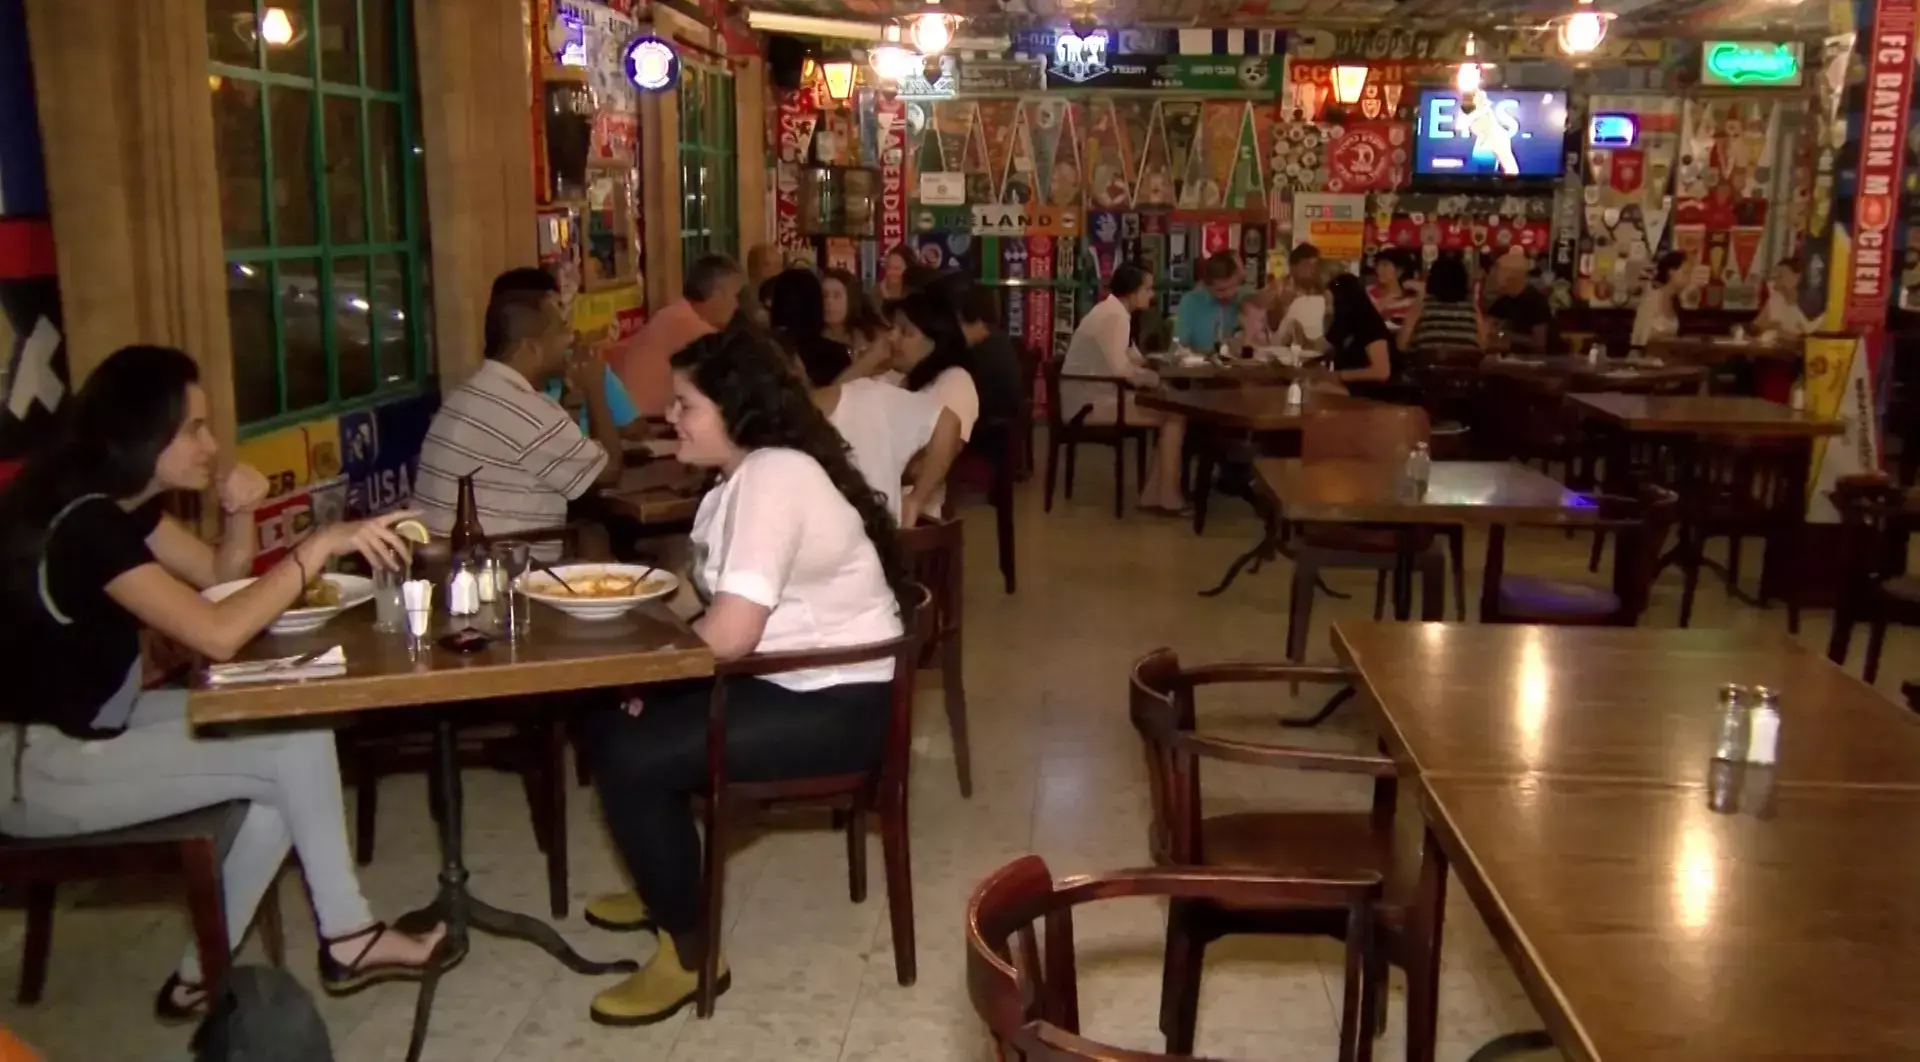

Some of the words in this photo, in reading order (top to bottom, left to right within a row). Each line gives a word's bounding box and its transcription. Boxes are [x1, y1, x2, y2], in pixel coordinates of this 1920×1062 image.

[1878, 35, 1907, 64] FC
[1866, 72, 1903, 166] BAYERN
[943, 214, 1053, 227] IRELAND
[1853, 175, 1891, 295] MCHEN
[366, 462, 411, 510] USA
